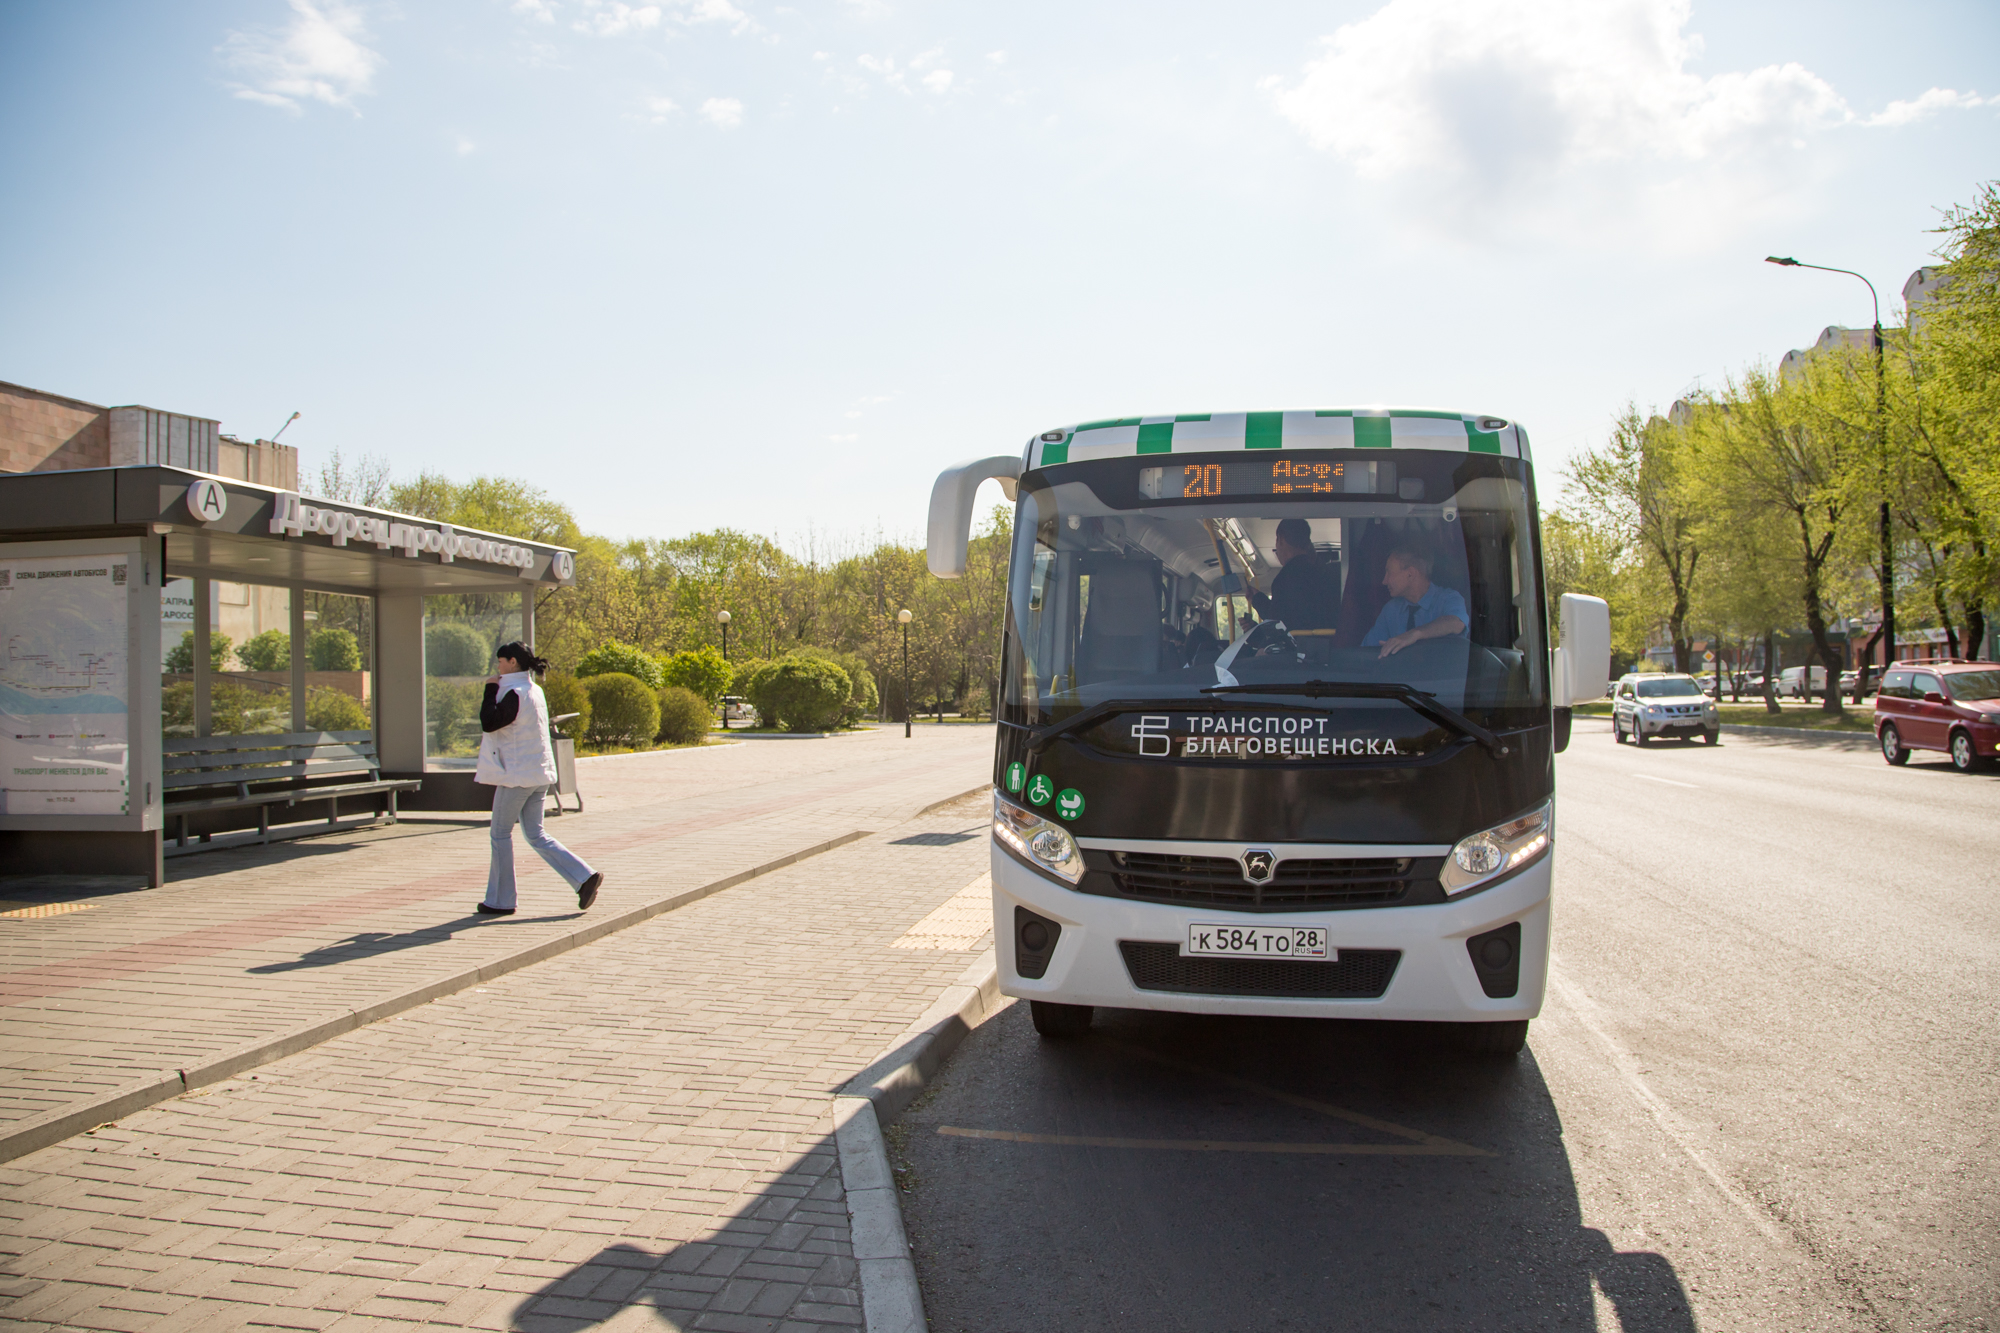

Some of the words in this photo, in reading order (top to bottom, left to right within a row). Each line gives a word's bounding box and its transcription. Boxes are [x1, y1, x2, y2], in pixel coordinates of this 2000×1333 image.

[1184, 464, 1222, 498] 20
[202, 484, 222, 515] А
[271, 491, 390, 550] Дворец
[391, 522, 535, 569] профсоюзов
[16, 571, 36, 580] СХЕМА
[37, 570, 72, 579] ДВИЖЕНИЯ
[73, 568, 108, 577] АВТОБУСОВ
[1186, 716, 1328, 735] ТРАНСПОРТ
[1186, 737, 1398, 757] БЛАГОВЕЩЕНСКА
[81, 768, 95, 776] ДЛЯ
[1295, 930, 1318, 948] 28
